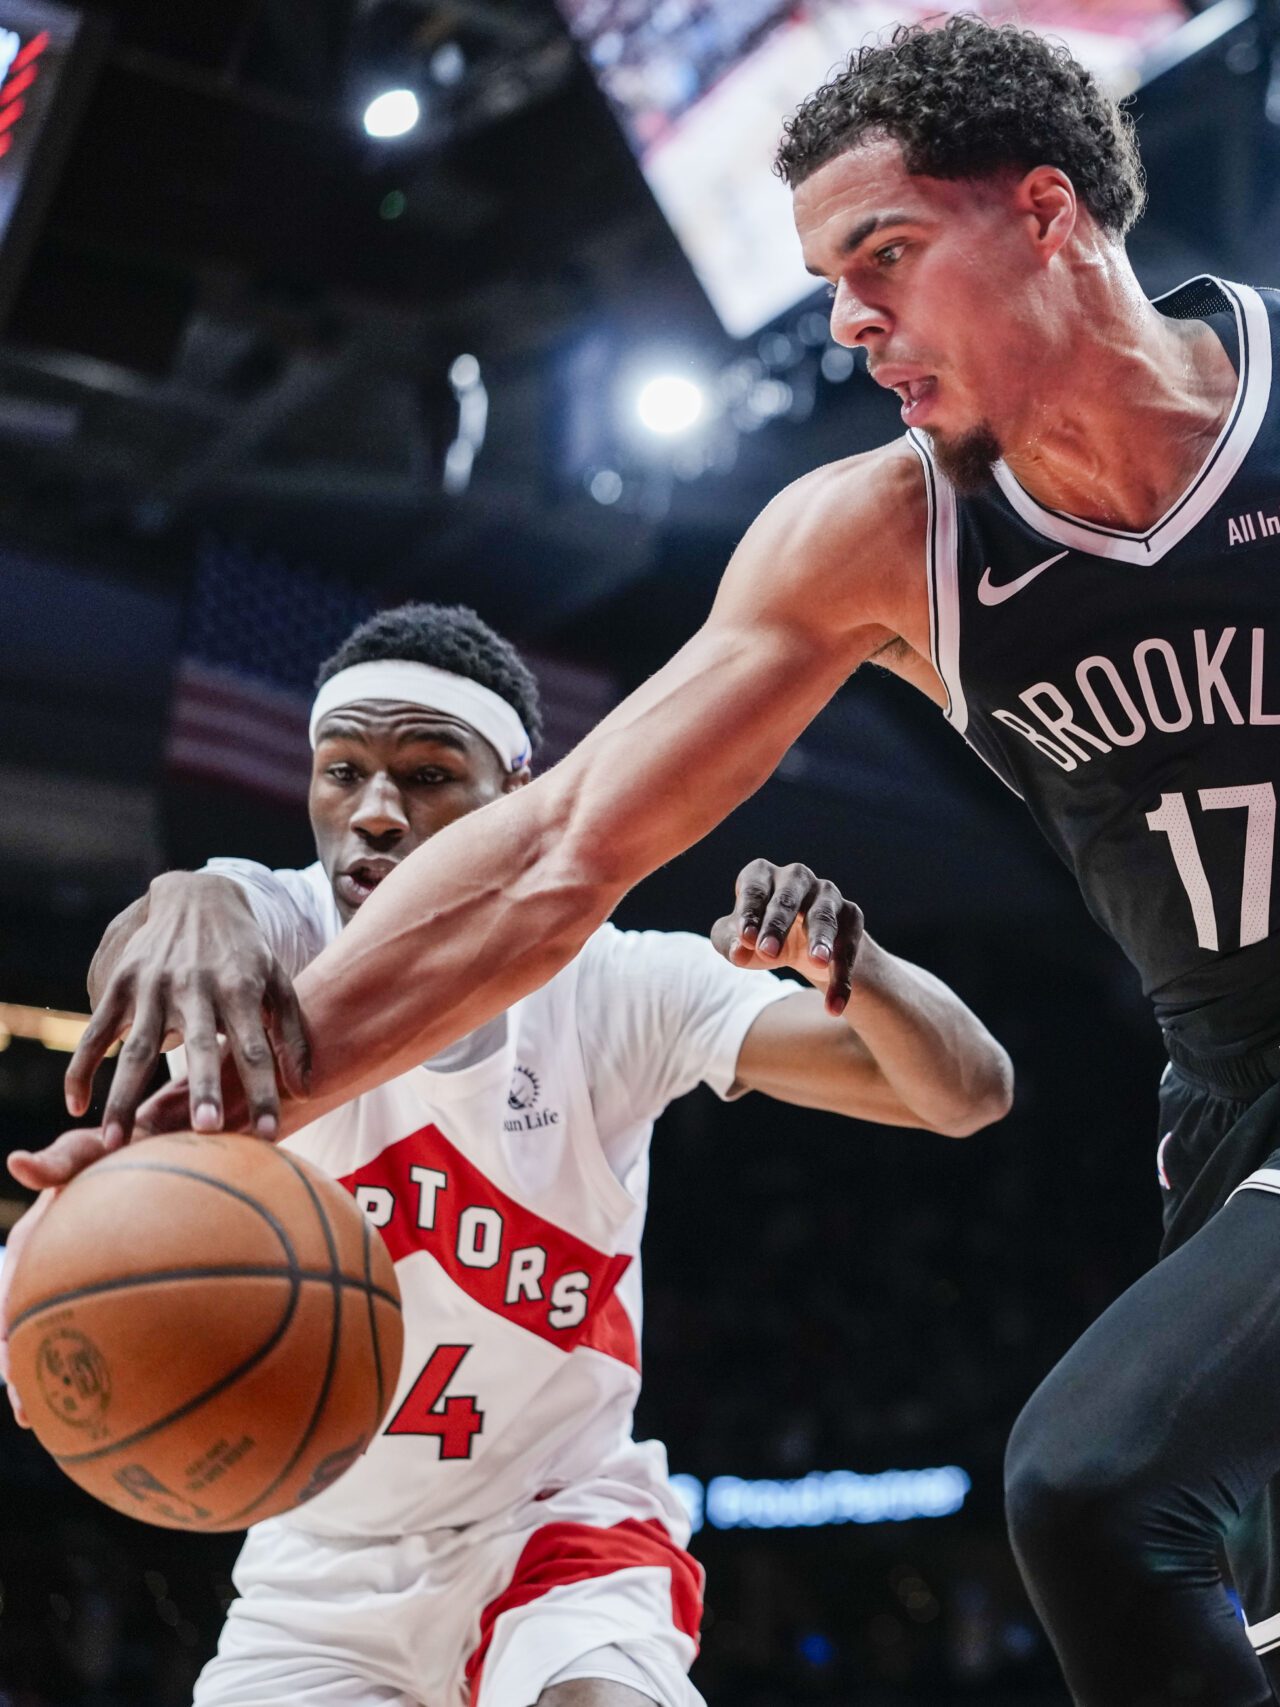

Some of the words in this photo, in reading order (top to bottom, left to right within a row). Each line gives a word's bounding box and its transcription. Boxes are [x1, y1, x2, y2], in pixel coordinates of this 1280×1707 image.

[1228, 513, 1257, 546] All
[1145, 782, 1276, 952] 17
[504, 1119, 523, 1132] un
[524, 1107, 558, 1130] Life
[383, 1344, 485, 1461] 4
